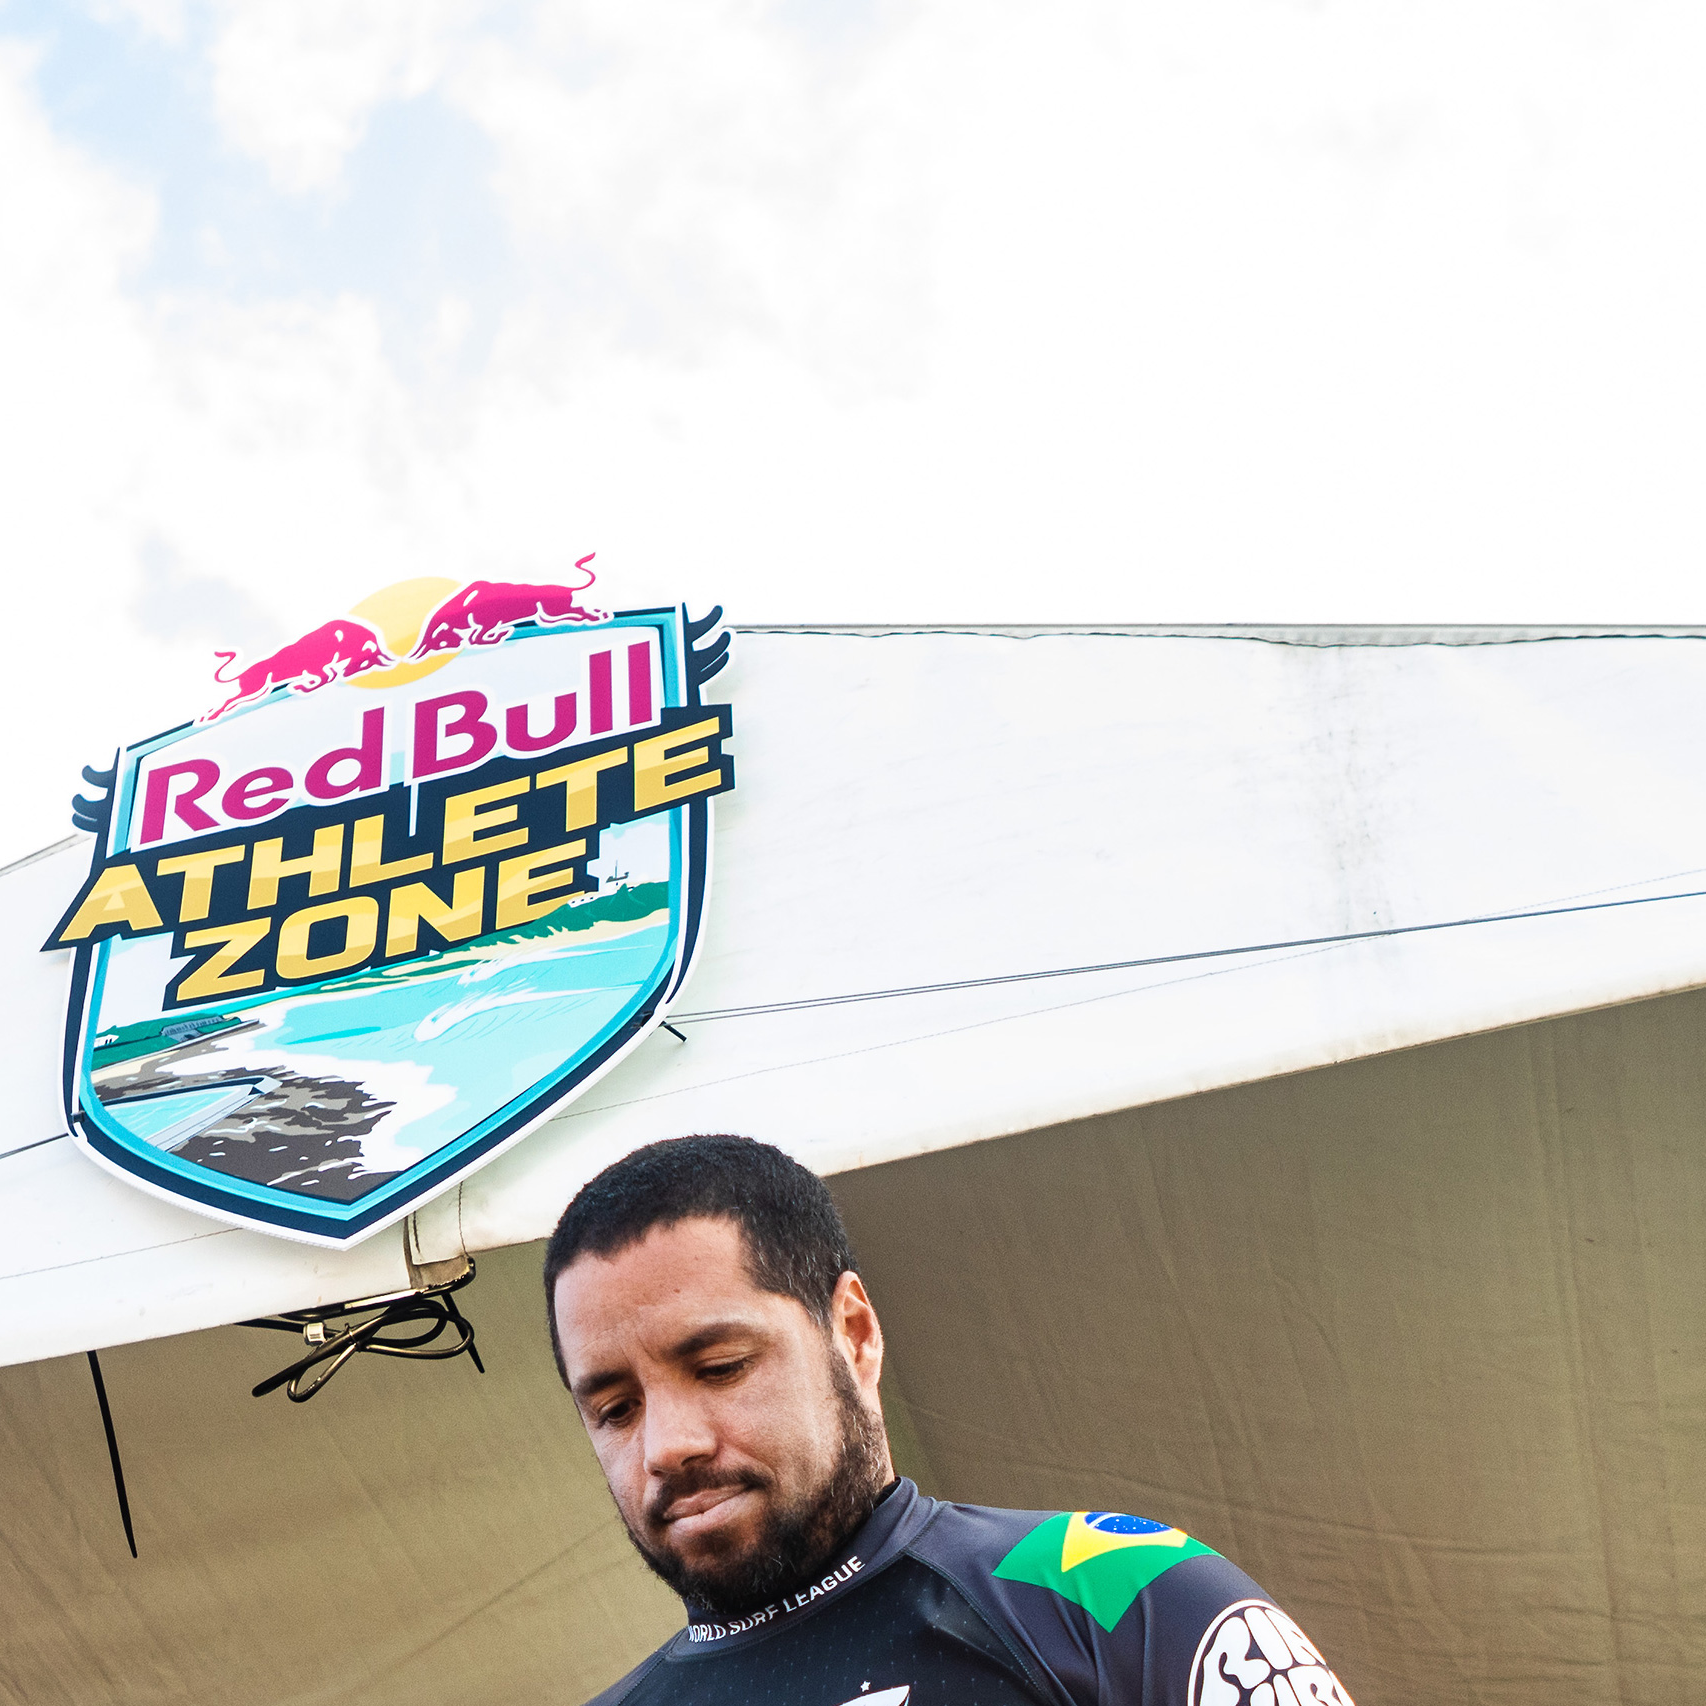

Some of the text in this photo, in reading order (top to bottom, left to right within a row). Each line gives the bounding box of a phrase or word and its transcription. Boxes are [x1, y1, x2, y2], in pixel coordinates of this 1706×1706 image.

[65, 717, 723, 941] ATHLETE
[139, 640, 654, 846] Red Bull
[176, 839, 587, 1002] ZONE
[728, 1604, 779, 1636] SURF
[782, 1555, 866, 1613] LEAGUE
